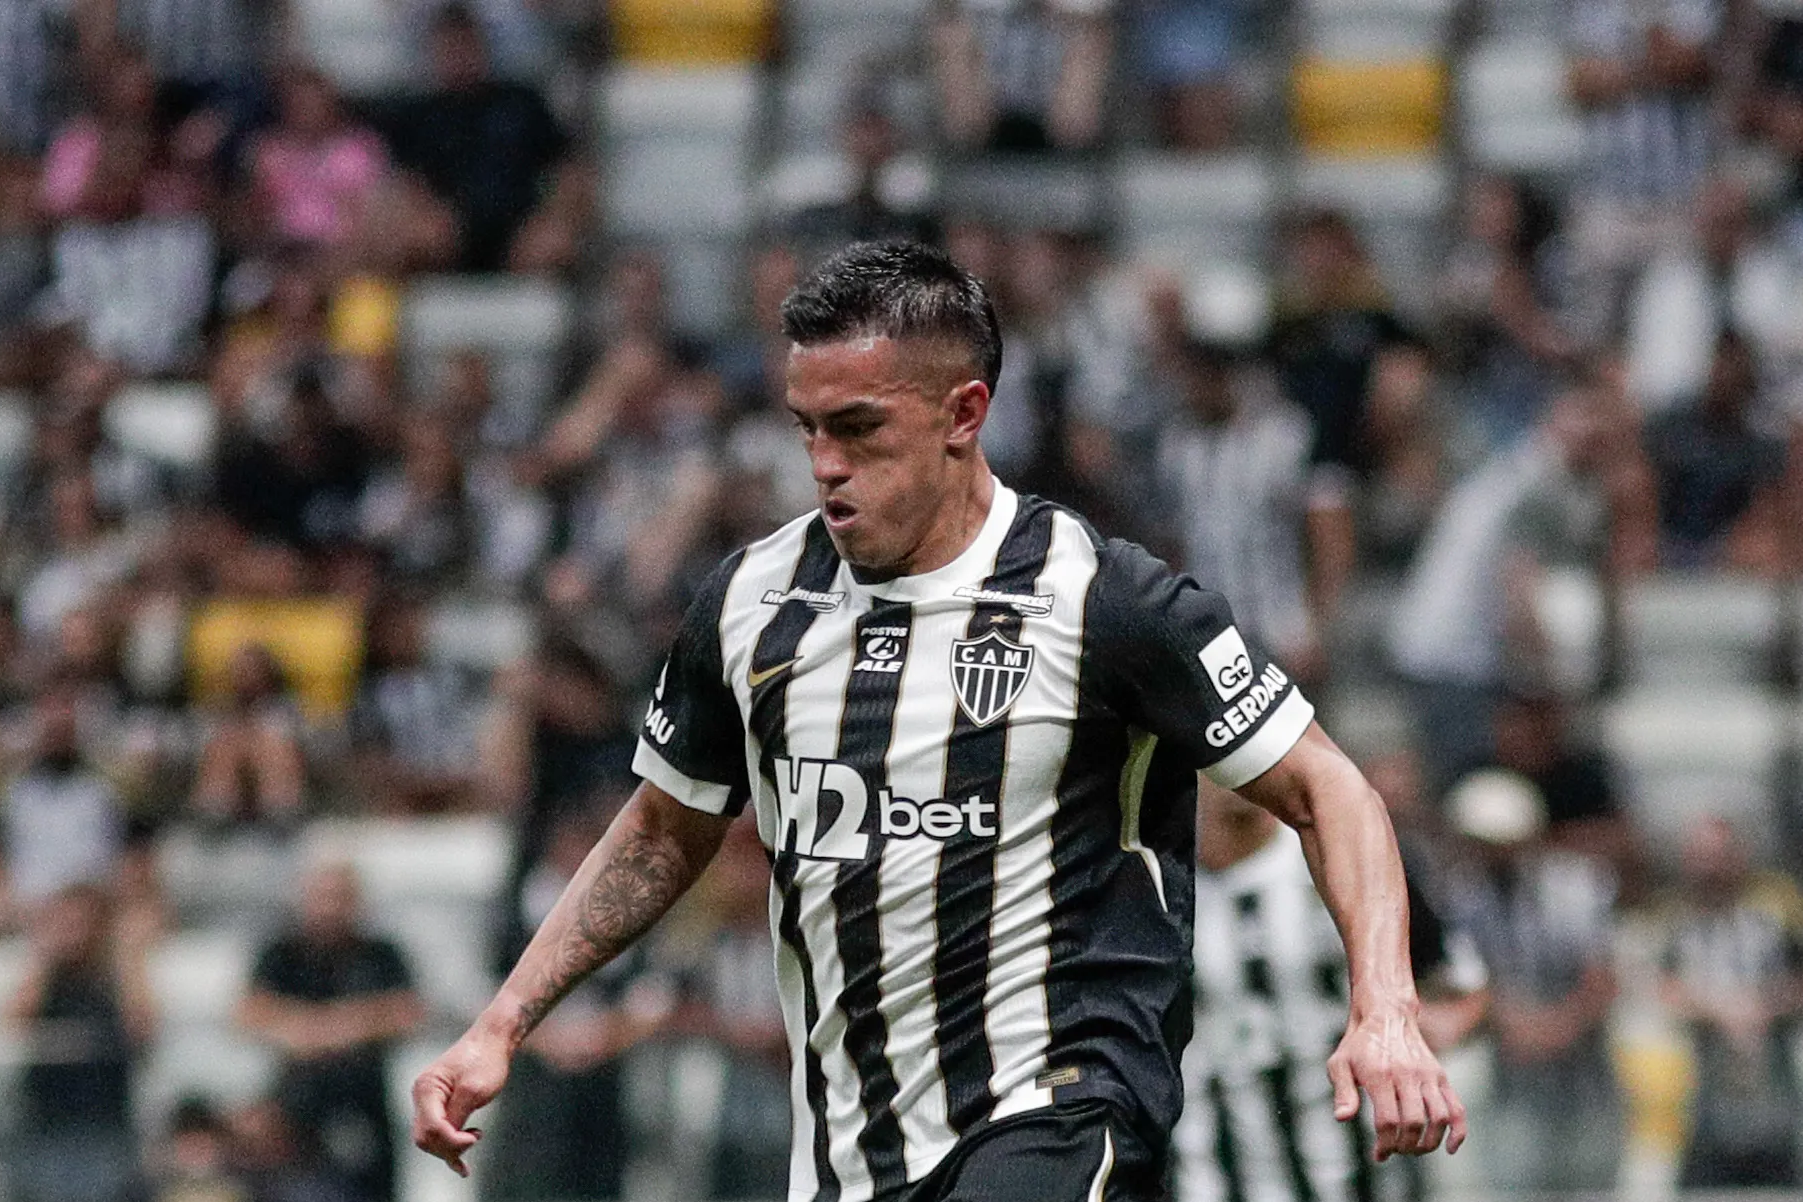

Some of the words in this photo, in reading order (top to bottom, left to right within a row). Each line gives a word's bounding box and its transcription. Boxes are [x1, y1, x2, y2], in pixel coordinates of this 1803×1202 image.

[861, 627, 908, 637] POSTOS
[961, 646, 1022, 666] CAM
[854, 661, 903, 672] ALE
[1205, 662, 1288, 748] GERDAU
[774, 758, 869, 860] H2
[878, 788, 996, 837] bet
